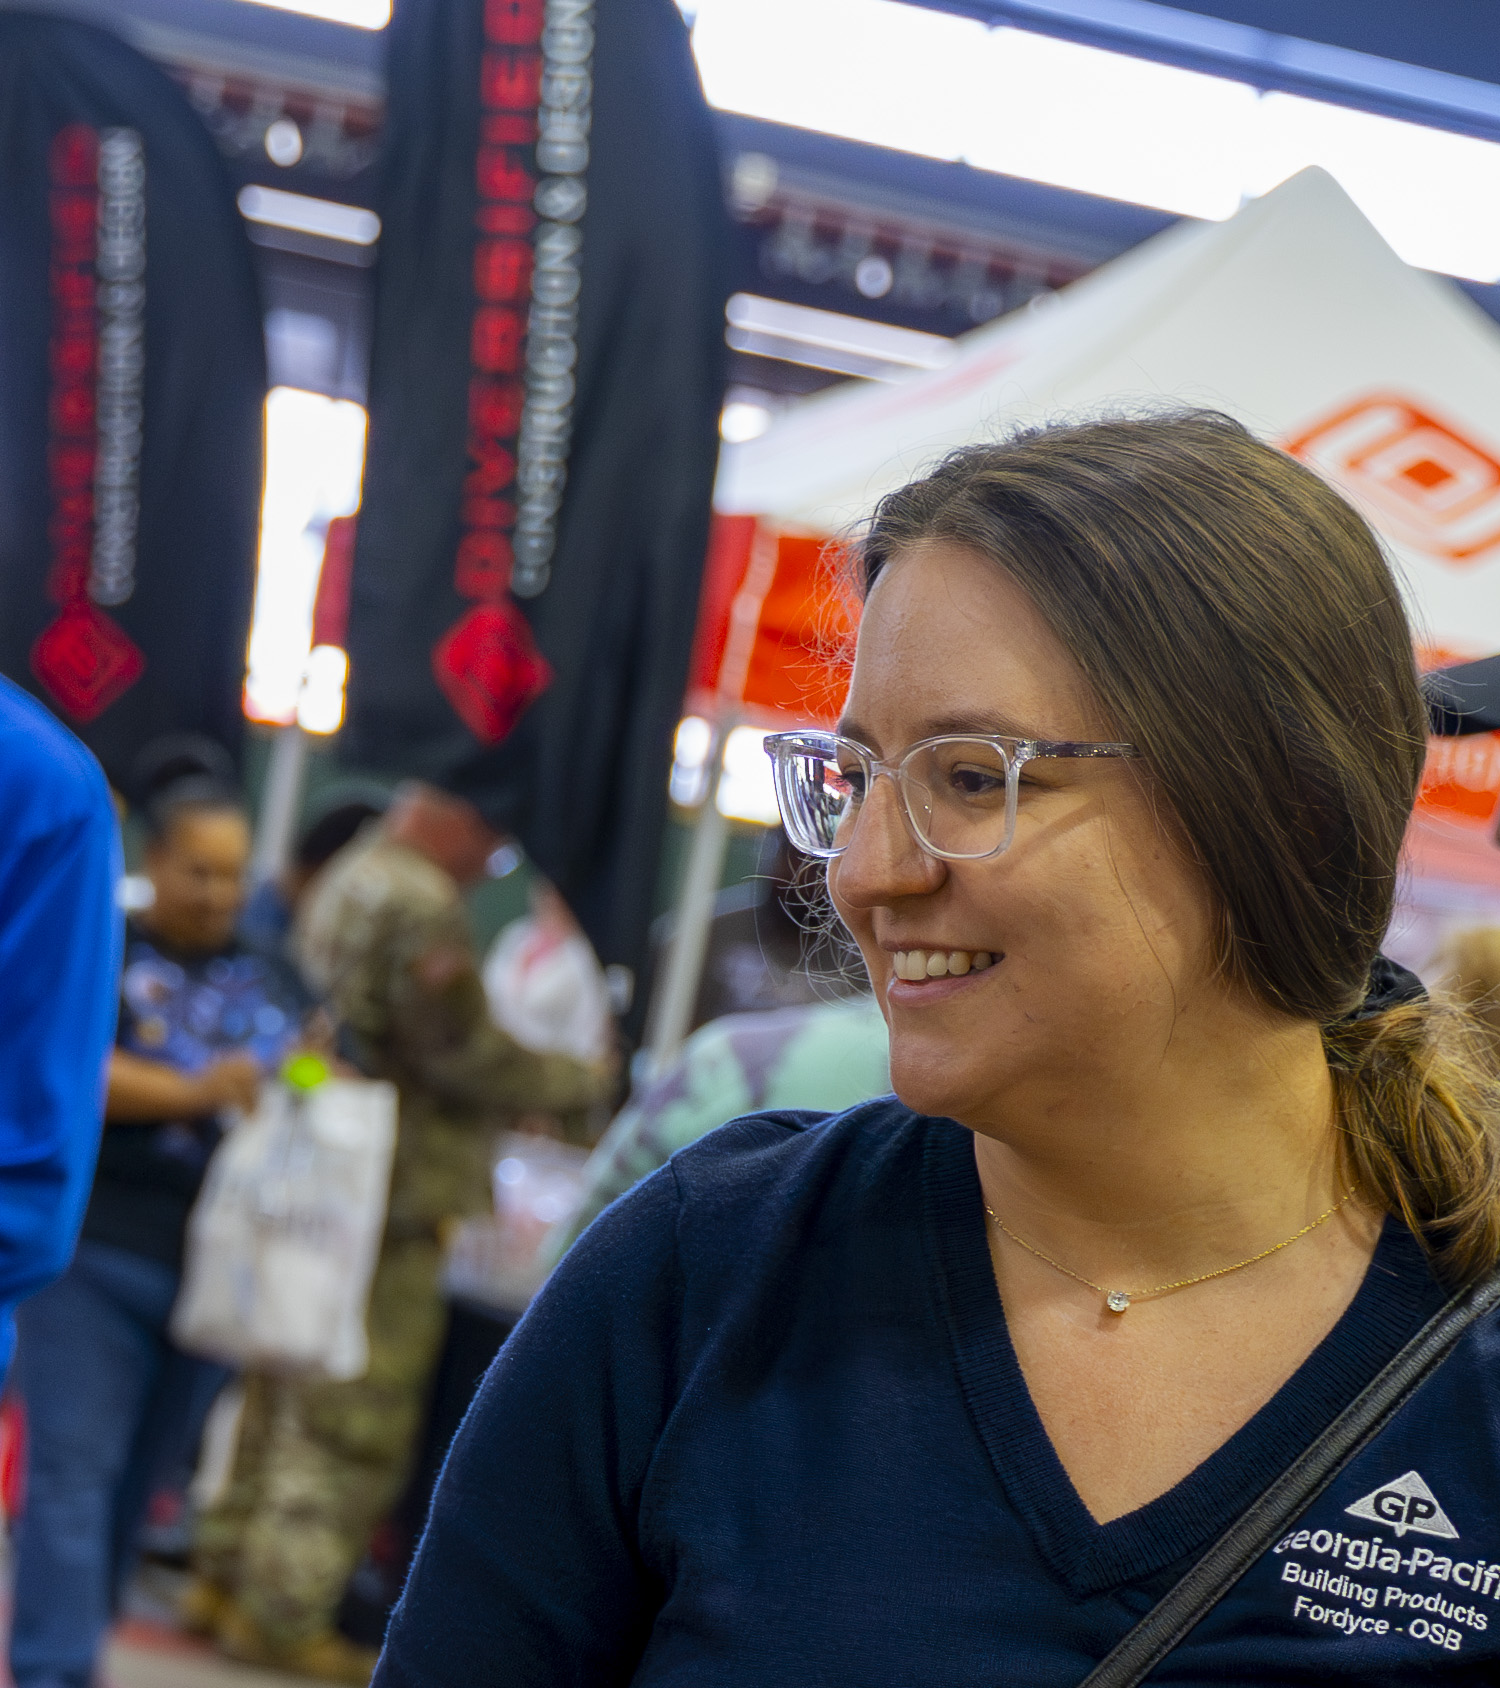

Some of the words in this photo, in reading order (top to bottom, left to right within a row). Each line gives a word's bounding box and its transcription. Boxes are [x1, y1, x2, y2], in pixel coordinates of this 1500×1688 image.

[1374, 1491, 1436, 1525] GP
[1281, 1562, 1379, 1608] Building
[1384, 1586, 1488, 1631] Products
[1294, 1595, 1390, 1635] Fordyce
[1408, 1618, 1463, 1651] OSB
